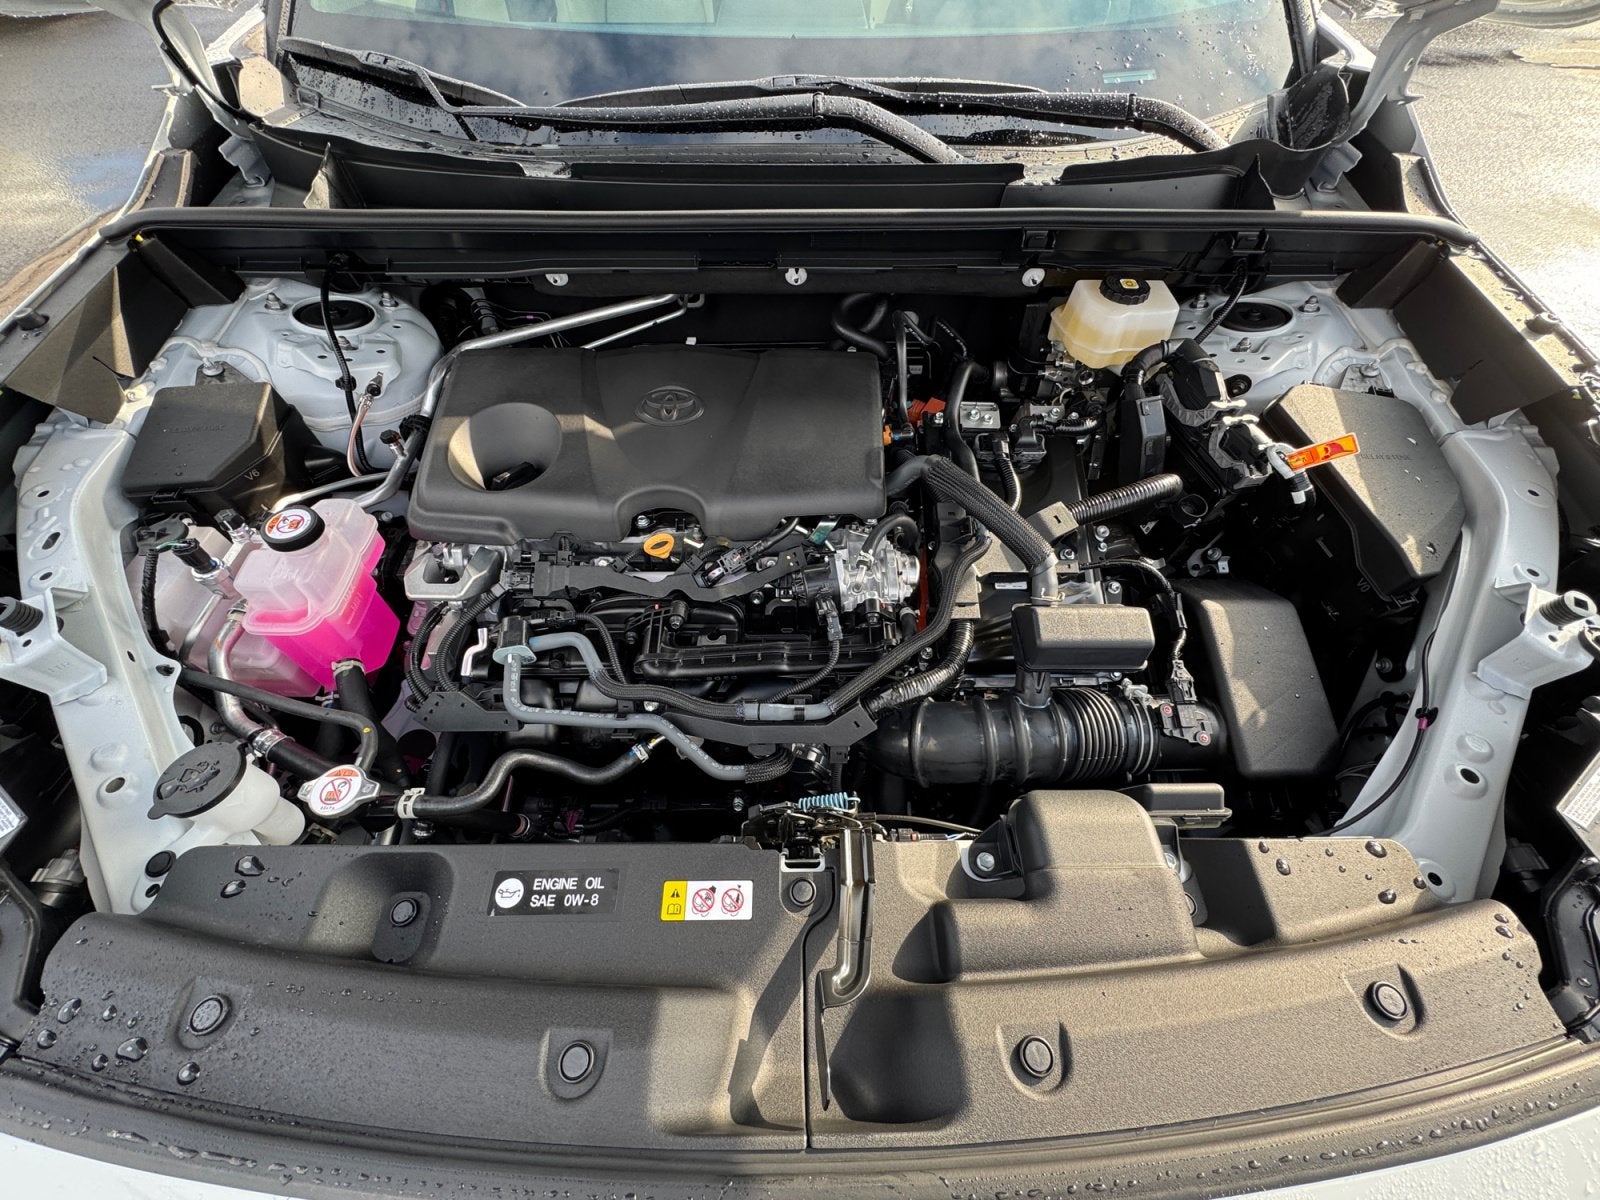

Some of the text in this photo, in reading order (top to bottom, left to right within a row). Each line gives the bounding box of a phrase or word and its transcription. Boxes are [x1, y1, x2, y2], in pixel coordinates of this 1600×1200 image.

[244, 469, 260, 481] V6
[533, 877, 605, 890] ENGINE OIL
[529, 893, 599, 907] SAE 0W-8
